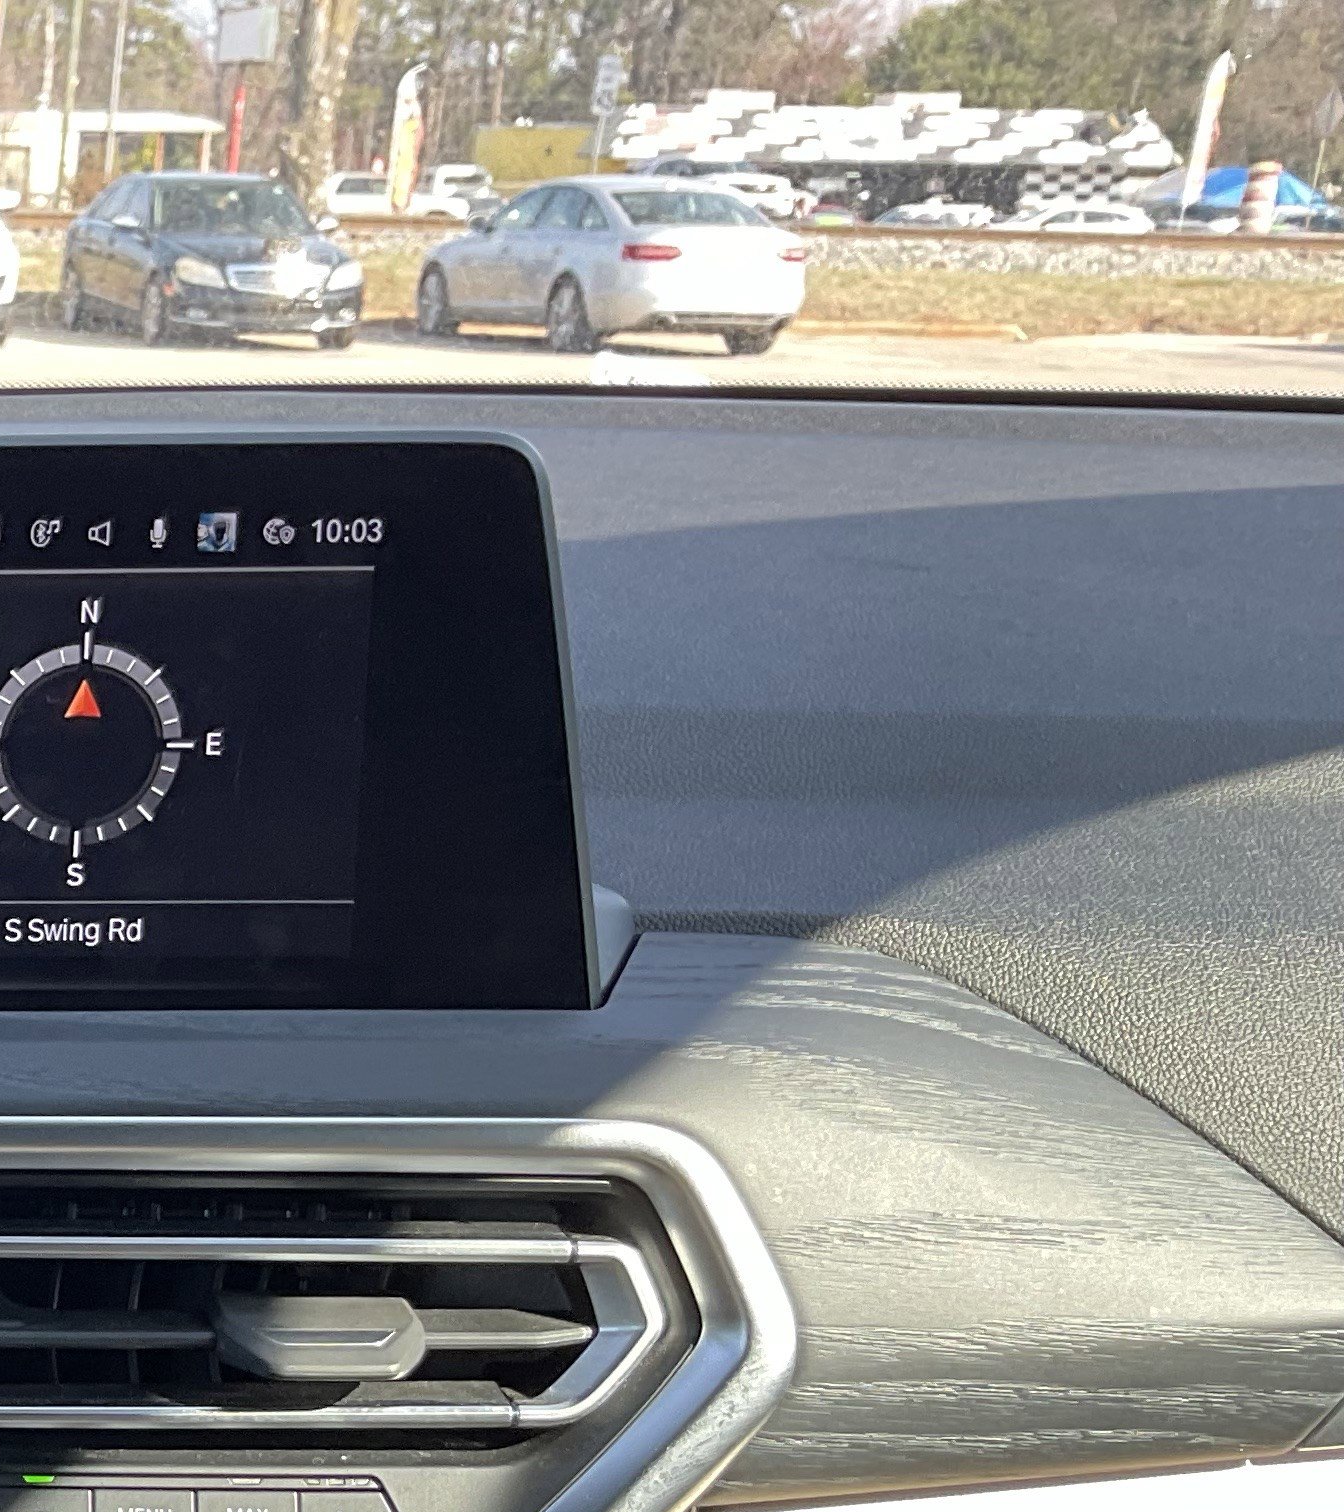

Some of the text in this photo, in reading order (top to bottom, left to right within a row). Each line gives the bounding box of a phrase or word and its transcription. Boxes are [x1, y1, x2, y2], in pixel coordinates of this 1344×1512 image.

[311, 518, 384, 544] 10:03
[80, 600, 103, 624] N
[205, 732, 224, 755] E
[66, 863, 84, 887] S
[4, 917, 143, 946] S Swing Rd
